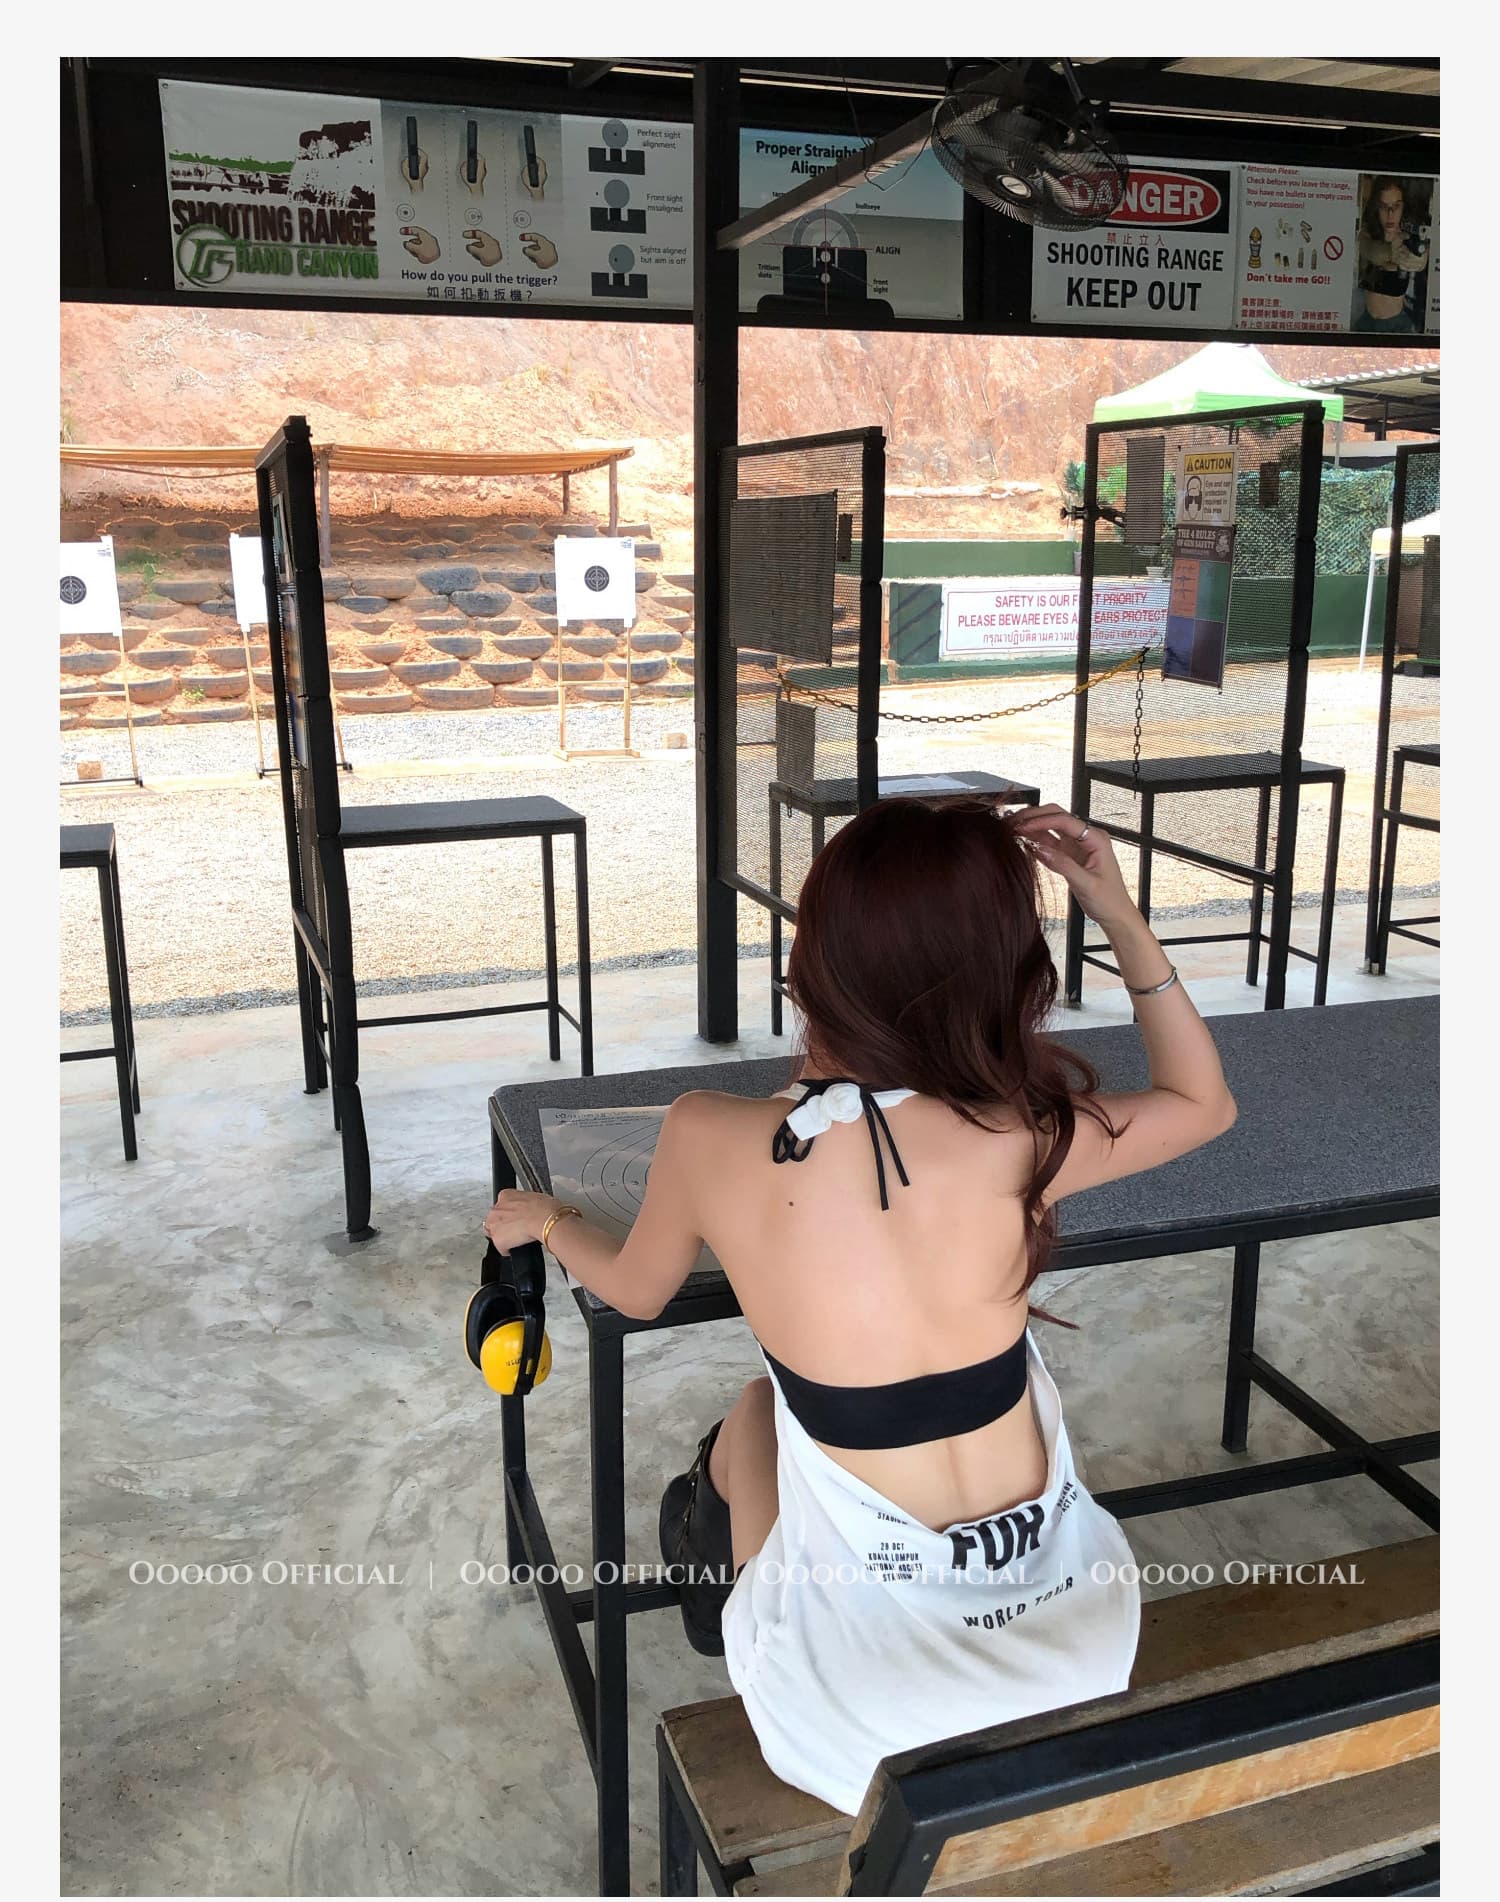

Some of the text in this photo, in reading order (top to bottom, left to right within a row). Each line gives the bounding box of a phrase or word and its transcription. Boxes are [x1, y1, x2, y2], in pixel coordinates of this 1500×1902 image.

[637, 129, 681, 140] Perfect sight
[643, 140, 676, 149] alignment
[756, 140, 856, 158] Proper Straigh
[791, 160, 832, 177] Align
[1247, 176, 1265, 184] Check
[1267, 178, 1287, 186] before
[1289, 180, 1300, 188] you
[1302, 179, 1318, 188] leave
[1319, 181, 1330, 189] the
[647, 194, 683, 204] Front sight
[1071, 178, 1205, 217] DANGER
[1285, 190, 1307, 198] bullets
[1316, 192, 1336, 201] empty
[647, 204, 684, 214] misaligned
[855, 202, 881, 211] bullseye
[1253, 201, 1268, 209] your
[172, 199, 377, 247] SHOOTING RANGE
[640, 245, 687, 257] Sights aligned
[875, 246, 901, 255] ALIGN
[640, 255, 652, 264] but
[676, 257, 687, 265] off
[1047, 242, 1224, 272] SHOOTING RANGE
[297, 250, 379, 280] CANYON
[401, 270, 558, 287] How do you pull the trigger?
[873, 278, 888, 286] front
[1274, 274, 1293, 283] take
[1311, 275, 1331, 285] GO!!
[873, 286, 888, 294] sight
[1066, 276, 1202, 311] KEEP OUT
[1194, 457, 1232, 470] CAUTION
[1177, 528, 1216, 540] THE 4 RULES
[1195, 540, 1216, 549] SAFETY
[995, 595, 1034, 608] SAFETY
[1037, 595, 1046, 607] IS
[1049, 595, 1070, 607] OUR
[1103, 592, 1148, 606] PRIORITY
[958, 614, 997, 627] PLEASE
[999, 613, 1041, 626] BEWARE
[1043, 613, 1069, 625] EYES
[1094, 611, 1120, 624] EARS
[1122, 609, 1168, 623] PROTECT
[892, 1542, 905, 1551] OCT
[867, 1553, 919, 1562] KUALA LUMPUR
[963, 1576, 1074, 1630] WORLD TOUR
